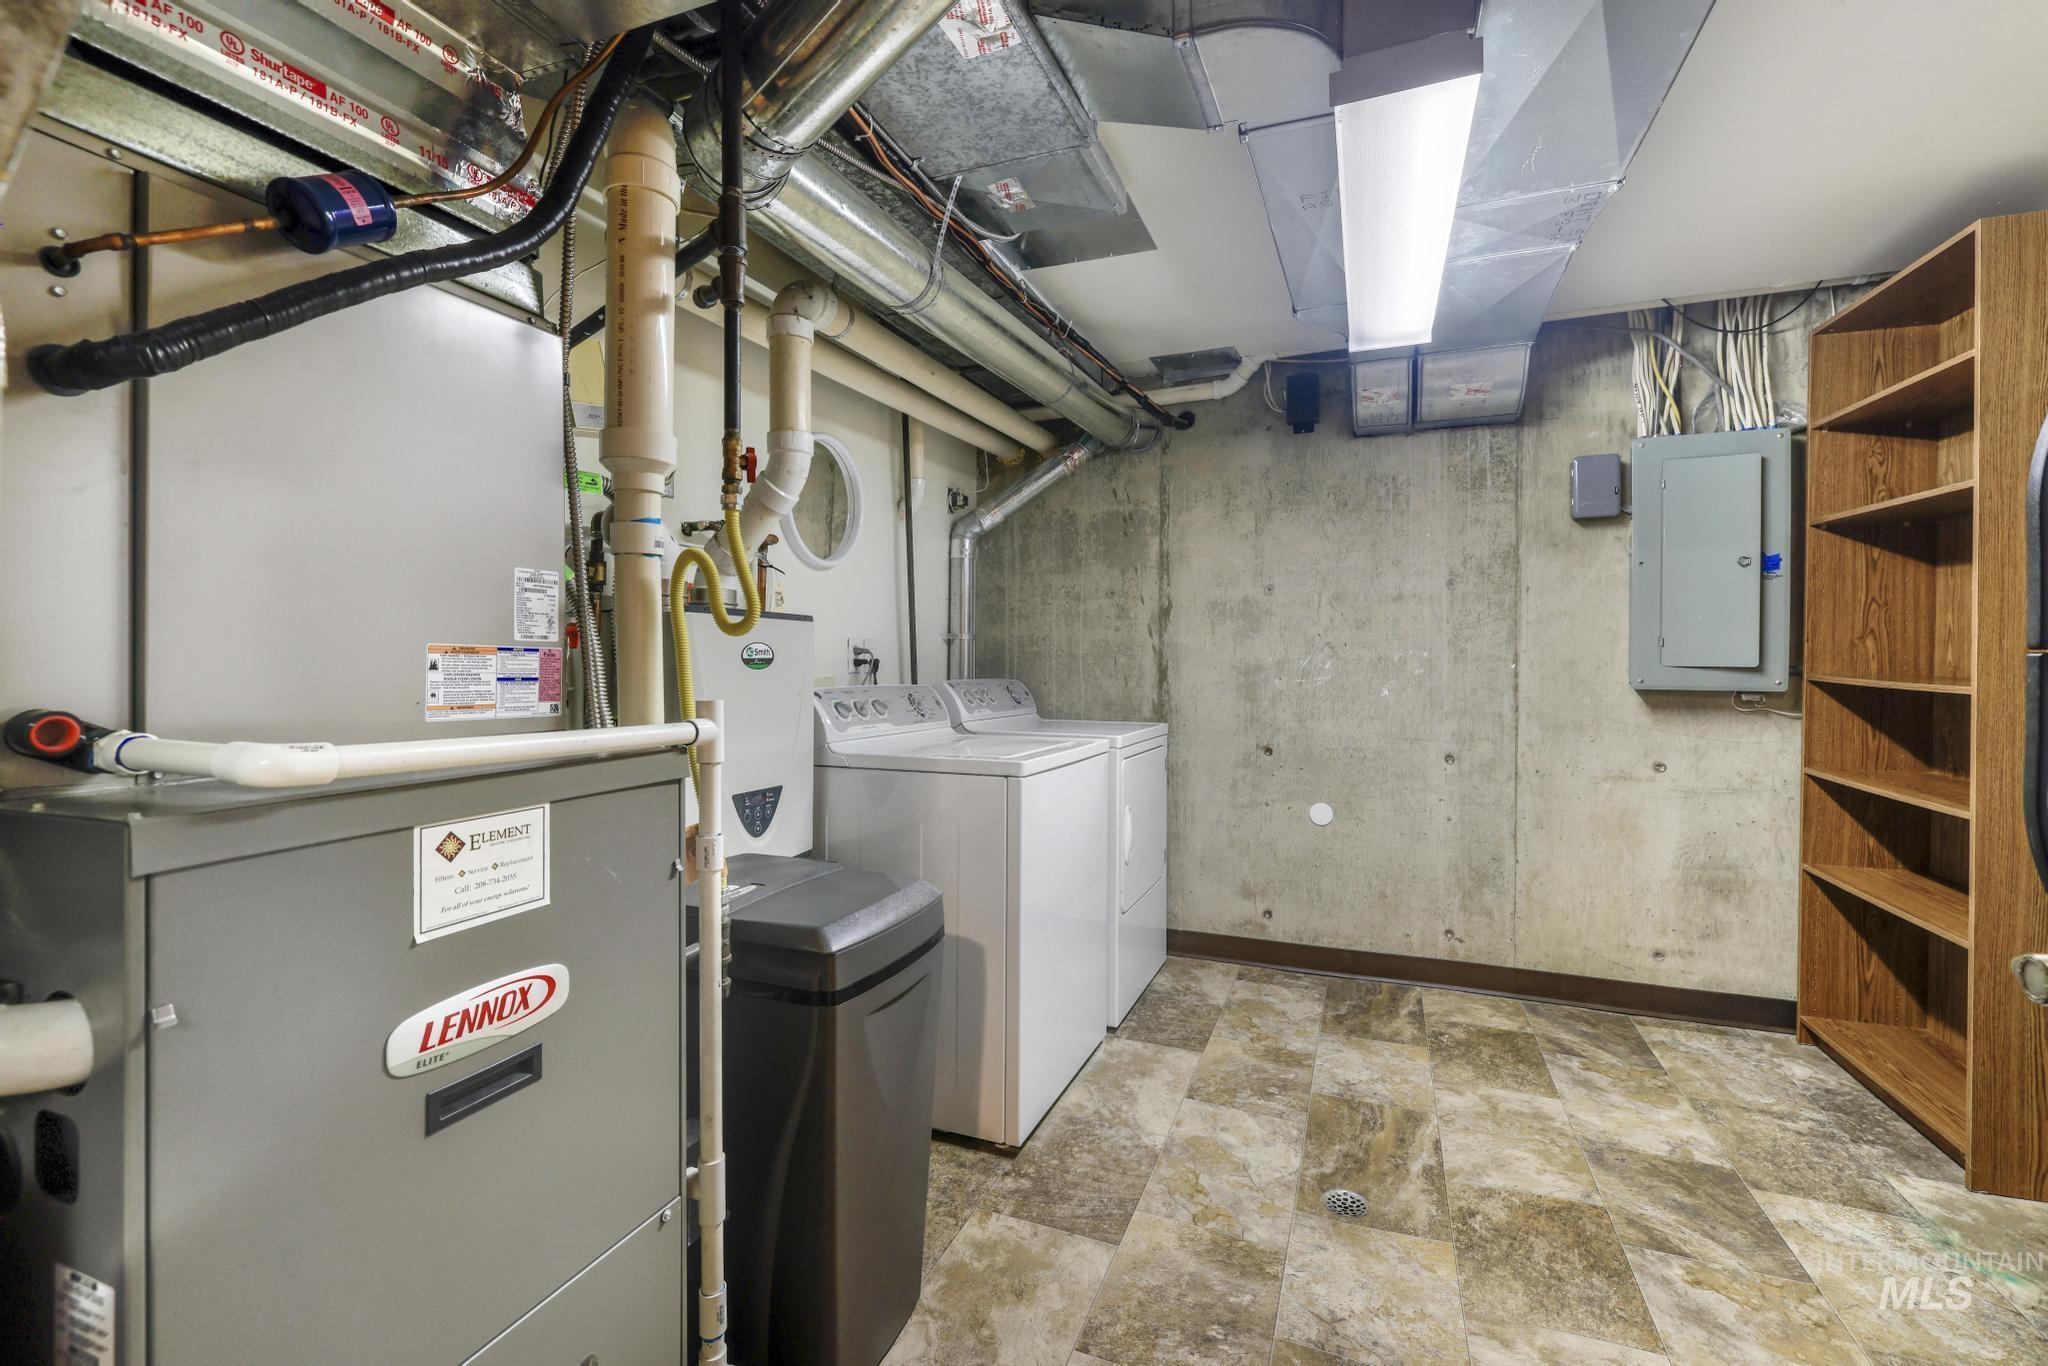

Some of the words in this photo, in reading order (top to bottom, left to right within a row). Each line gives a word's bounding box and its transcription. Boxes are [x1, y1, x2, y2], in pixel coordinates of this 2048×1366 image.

[125, 1, 188, 41] 181B-FX
[178, 12, 204, 33] 100
[397, 19, 412, 32] AF
[415, 29, 432, 47] 100
[378, 22, 420, 54] 181B-FX
[250, 48, 314, 90] Shurtape
[330, 92, 346, 106] AF
[349, 103, 369, 120] 100
[252, 67, 297, 95] 181A-P
[309, 96, 357, 127] 181B-FX
[618, 209, 628, 232] Made
[470, 823, 532, 851] ELEMENT
[435, 873, 454, 884] Filters
[467, 866, 489, 876] Service
[500, 855, 534, 868] Replacement
[454, 883, 471, 895] Call:
[474, 873, 517, 890] 208-734-2035
[440, 904, 451, 914] For
[418, 983, 533, 1054] LENNOX
